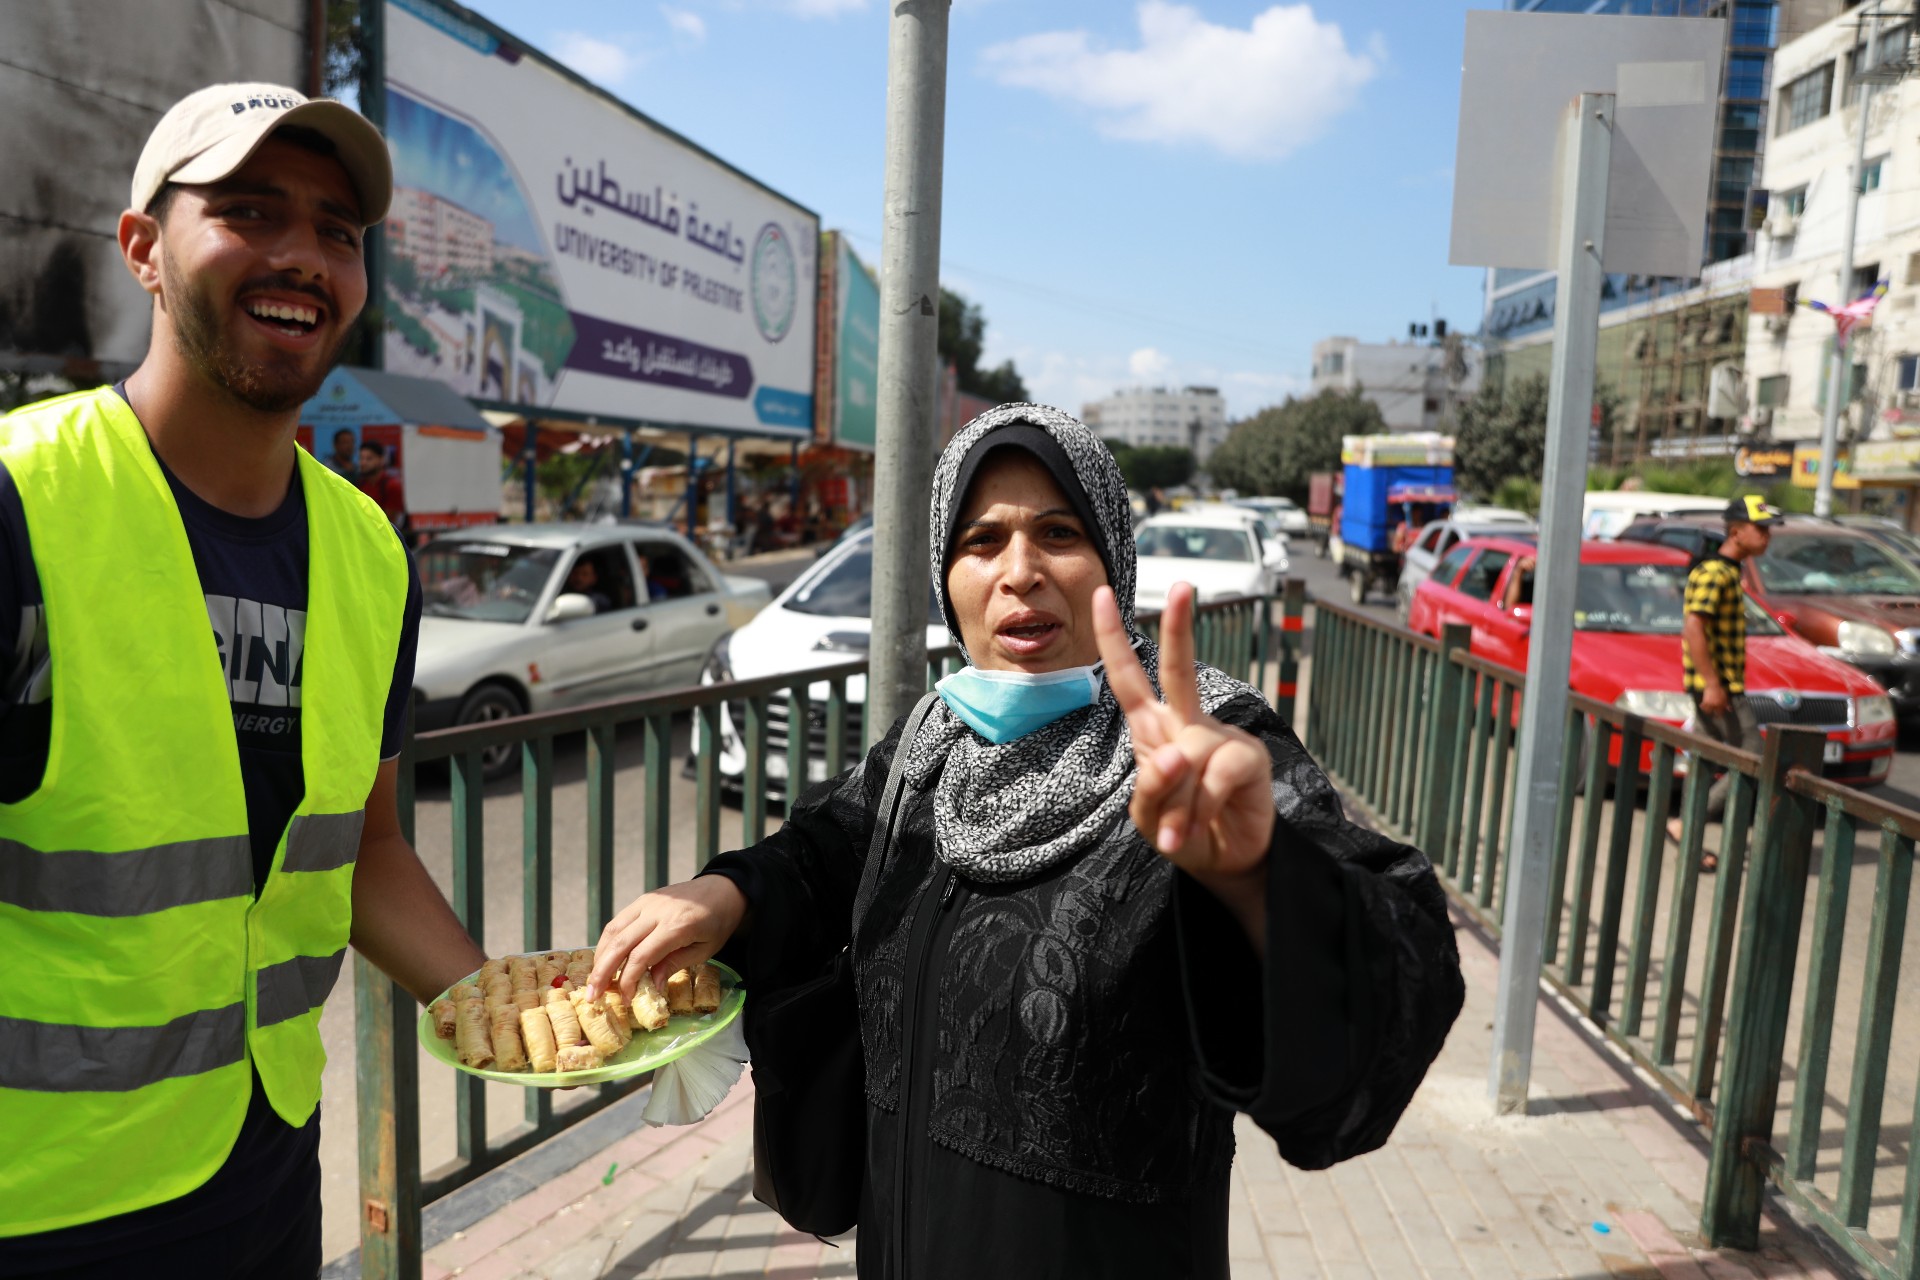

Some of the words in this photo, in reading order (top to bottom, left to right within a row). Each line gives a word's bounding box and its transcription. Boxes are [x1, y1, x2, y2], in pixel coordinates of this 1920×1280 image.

[556, 156, 681, 236] فلسطين
[555, 222, 657, 284] UNIVERSITY
[659, 260, 679, 291] OF
[682, 267, 745, 315] PALESTINE
[686, 202, 746, 273] جامعة
[233, 712, 297, 734] NERGY
